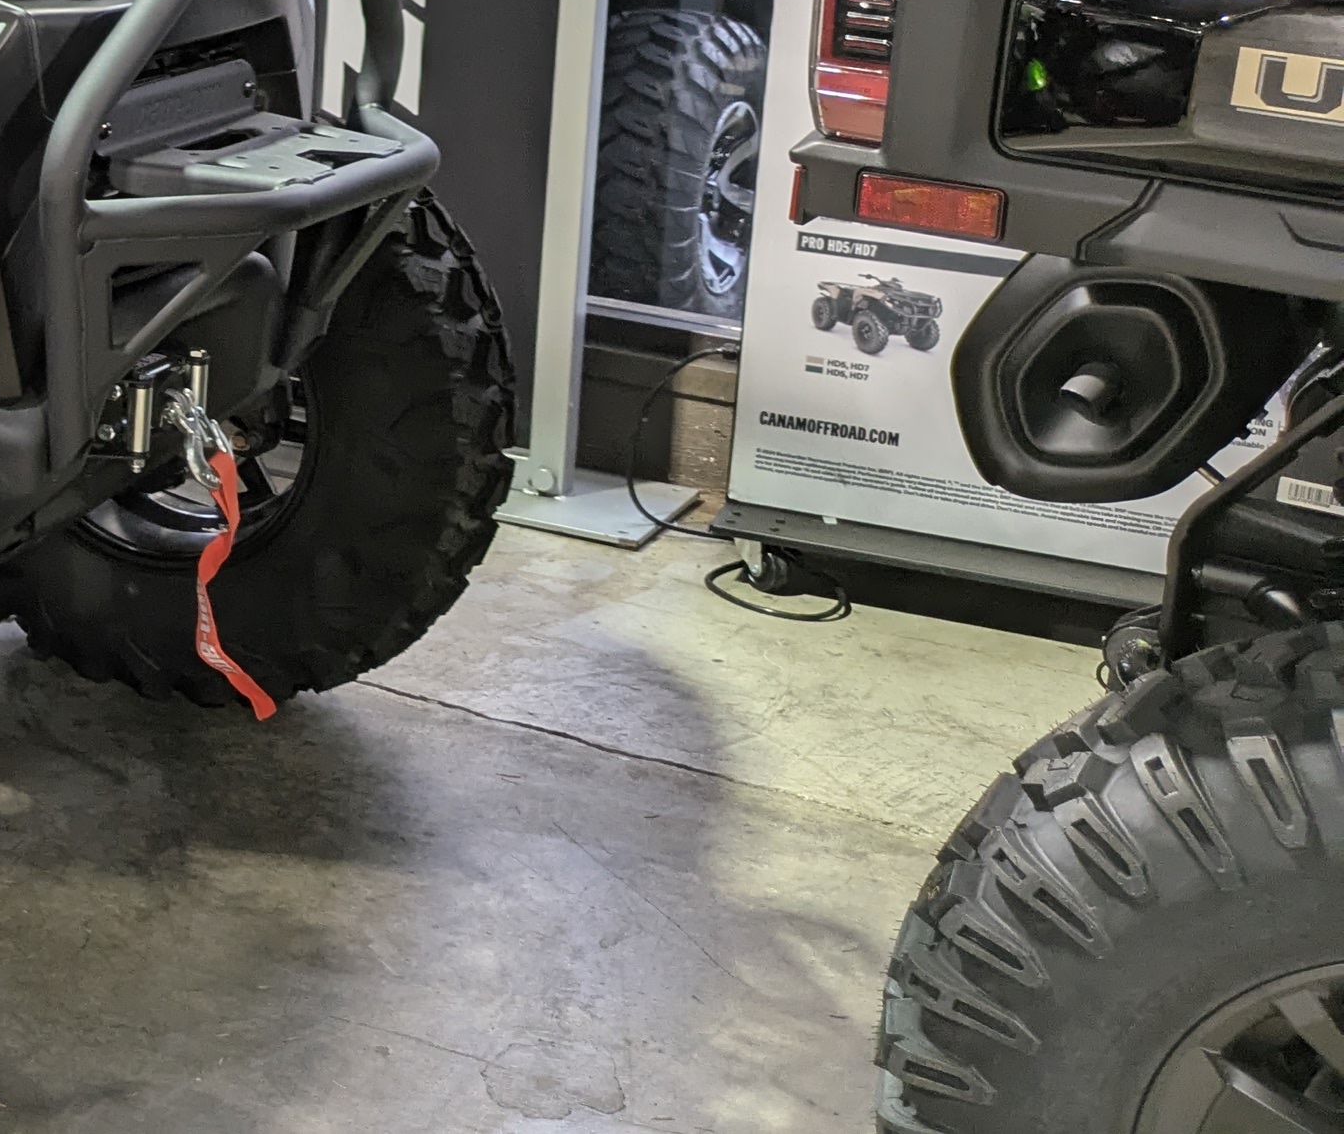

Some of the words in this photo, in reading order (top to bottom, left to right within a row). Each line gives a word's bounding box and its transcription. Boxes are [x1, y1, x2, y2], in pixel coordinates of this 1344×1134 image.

[800, 235, 825, 251] PRO
[827, 239, 878, 258] HD5/HD7
[850, 361, 870, 372] HD7
[849, 370, 869, 382] HD7
[759, 410, 900, 447] CANAMOFFROAD.COM
